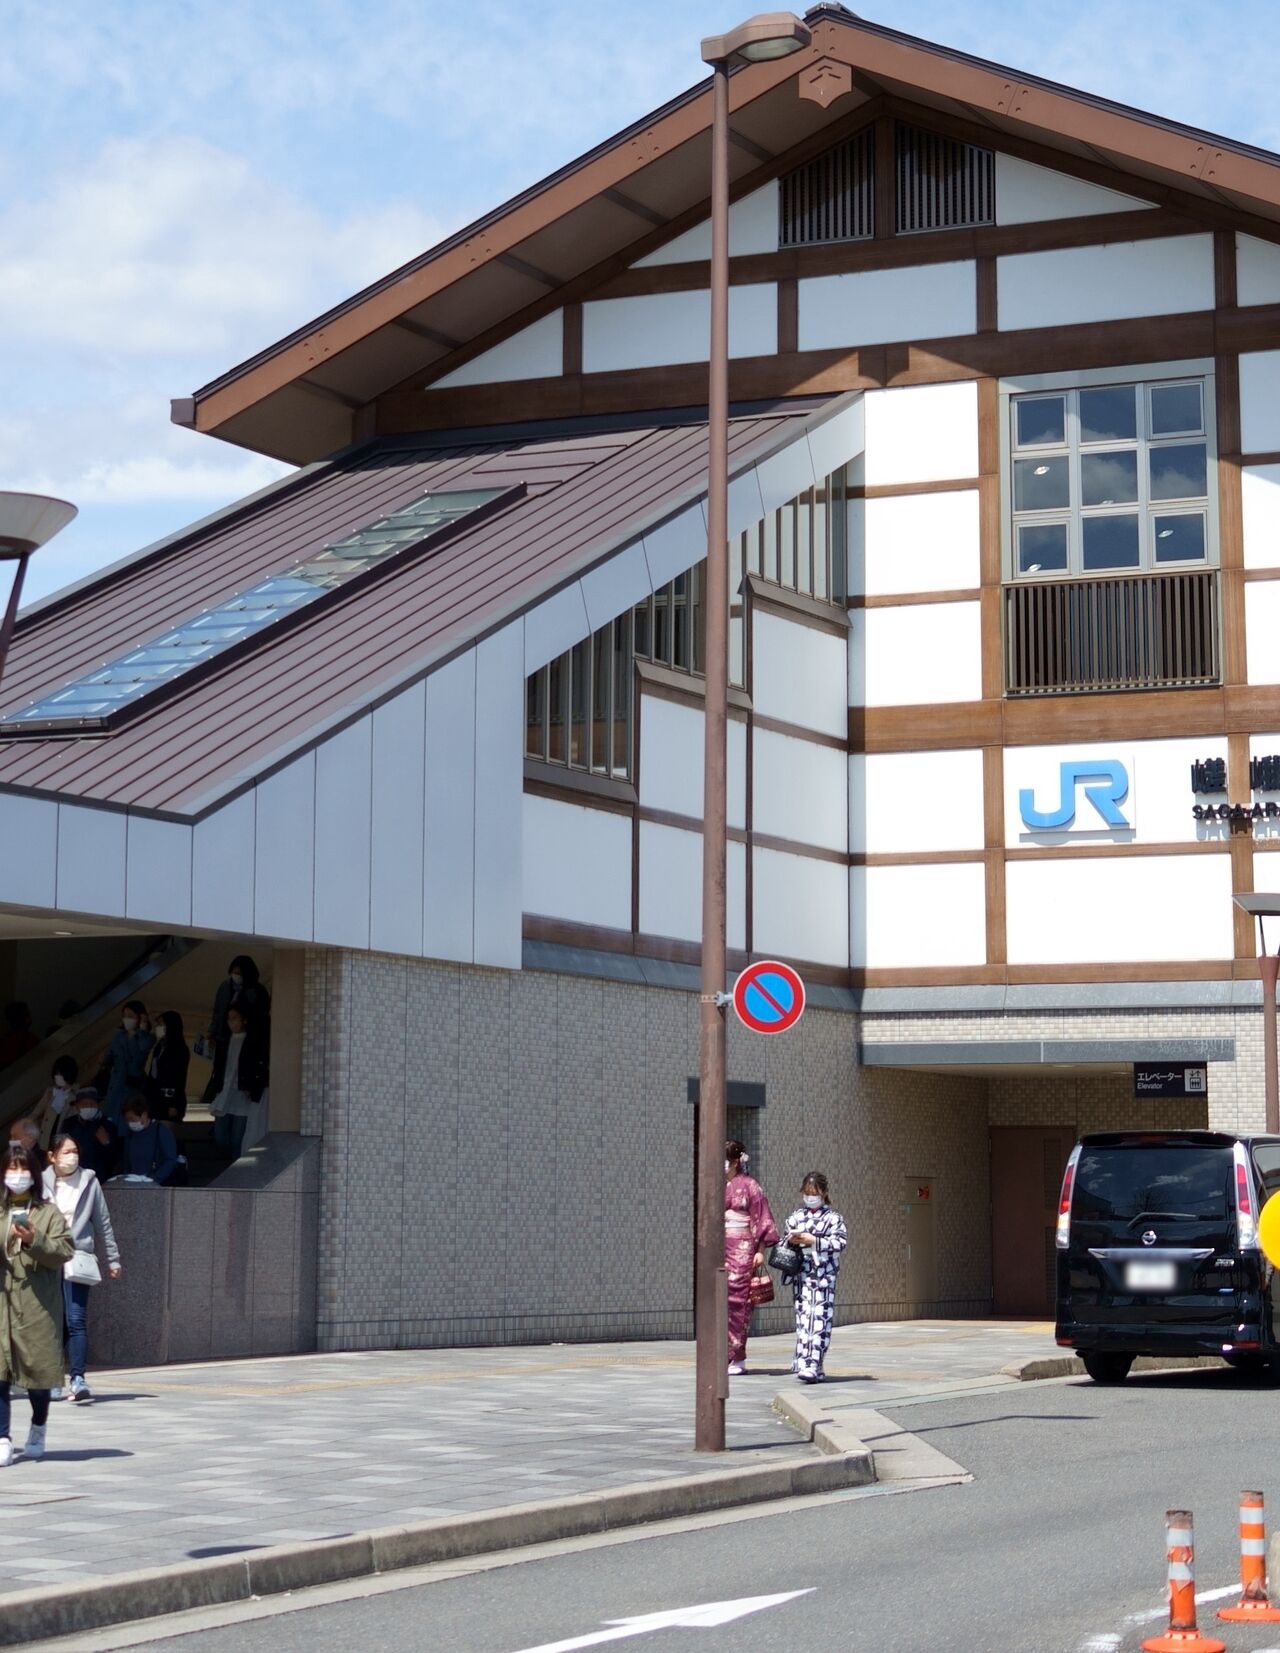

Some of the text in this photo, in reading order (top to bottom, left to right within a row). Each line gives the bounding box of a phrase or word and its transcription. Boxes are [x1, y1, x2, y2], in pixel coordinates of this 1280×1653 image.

[1019, 759, 1131, 829] JR
[1137, 1072, 1183, 1082] エレベーター
[1137, 1082, 1163, 1090] Elevator
